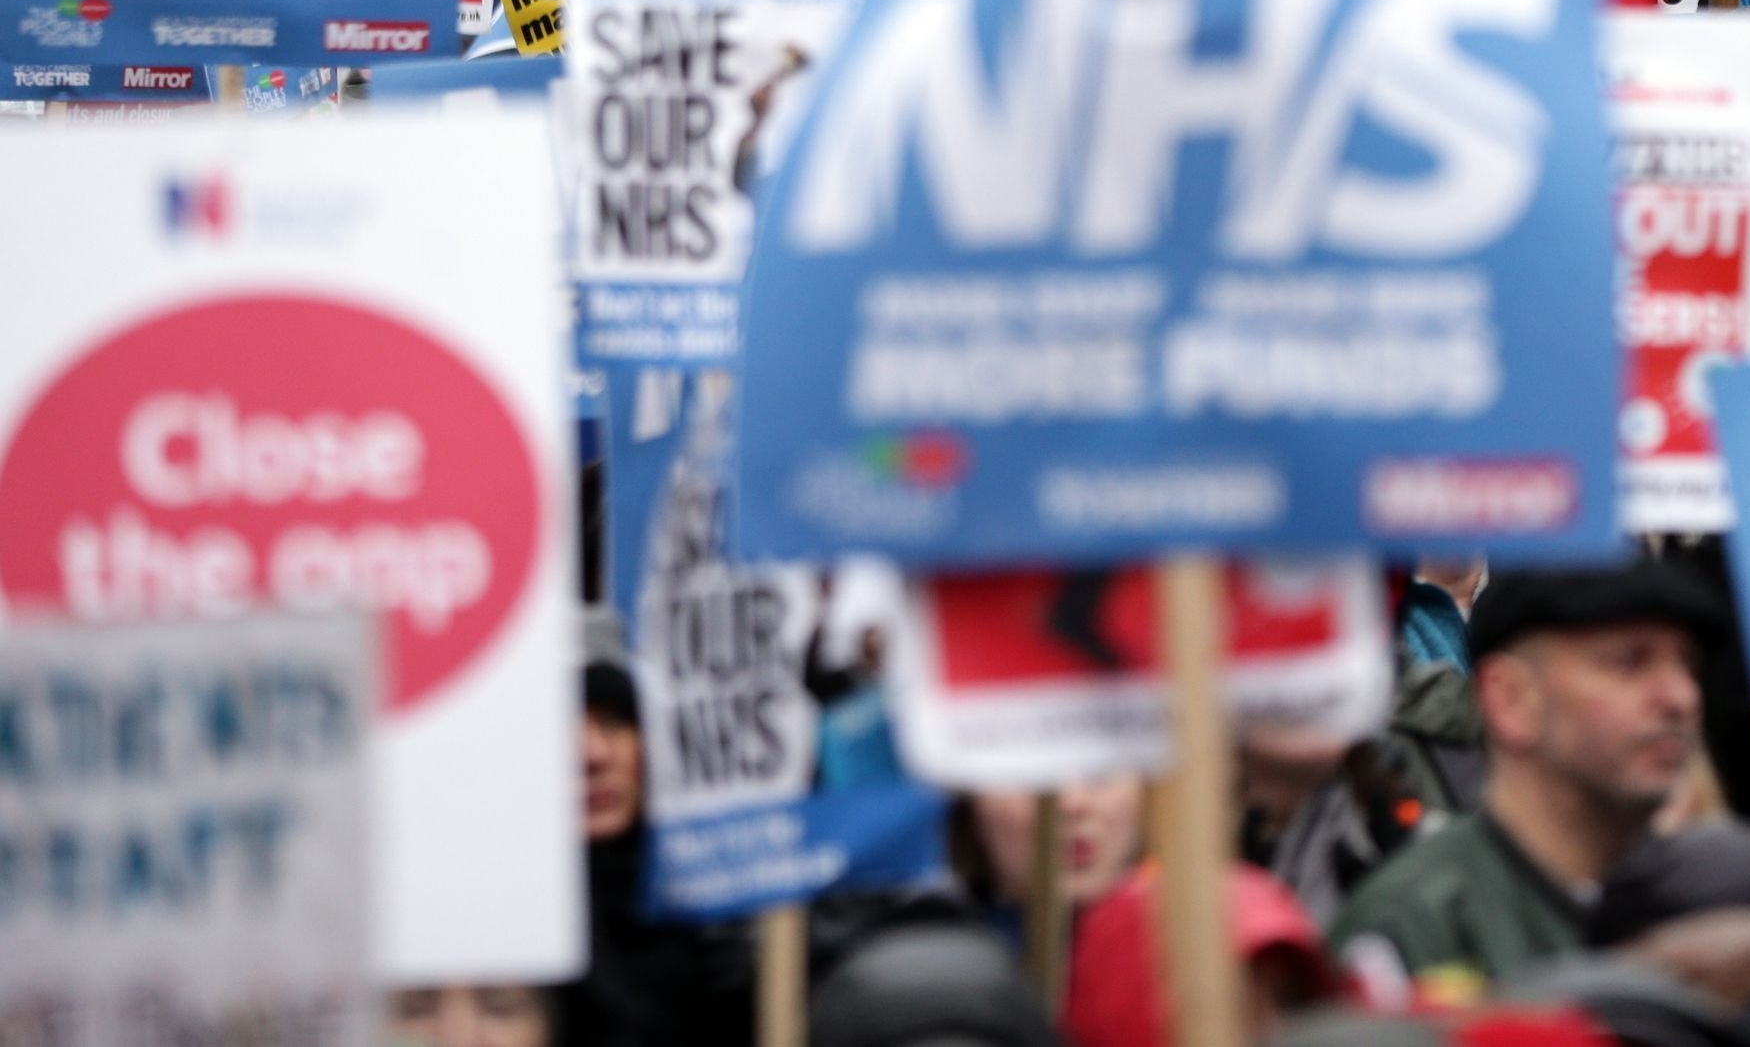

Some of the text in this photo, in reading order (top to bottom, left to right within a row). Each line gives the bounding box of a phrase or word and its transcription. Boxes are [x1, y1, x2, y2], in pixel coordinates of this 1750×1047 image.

[153, 25, 277, 47] TOGETHER
[325, 22, 430, 52] Mirror
[590, 7, 742, 87] SAVE
[14, 71, 91, 87] TOGETHER
[123, 67, 192, 88] Mirror
[593, 94, 718, 170] OUR
[594, 182, 719, 263] NHS
[122, 389, 427, 508] Close
[60, 505, 253, 621] the
[664, 593, 790, 684] OUR
[670, 691, 786, 789] NHS
